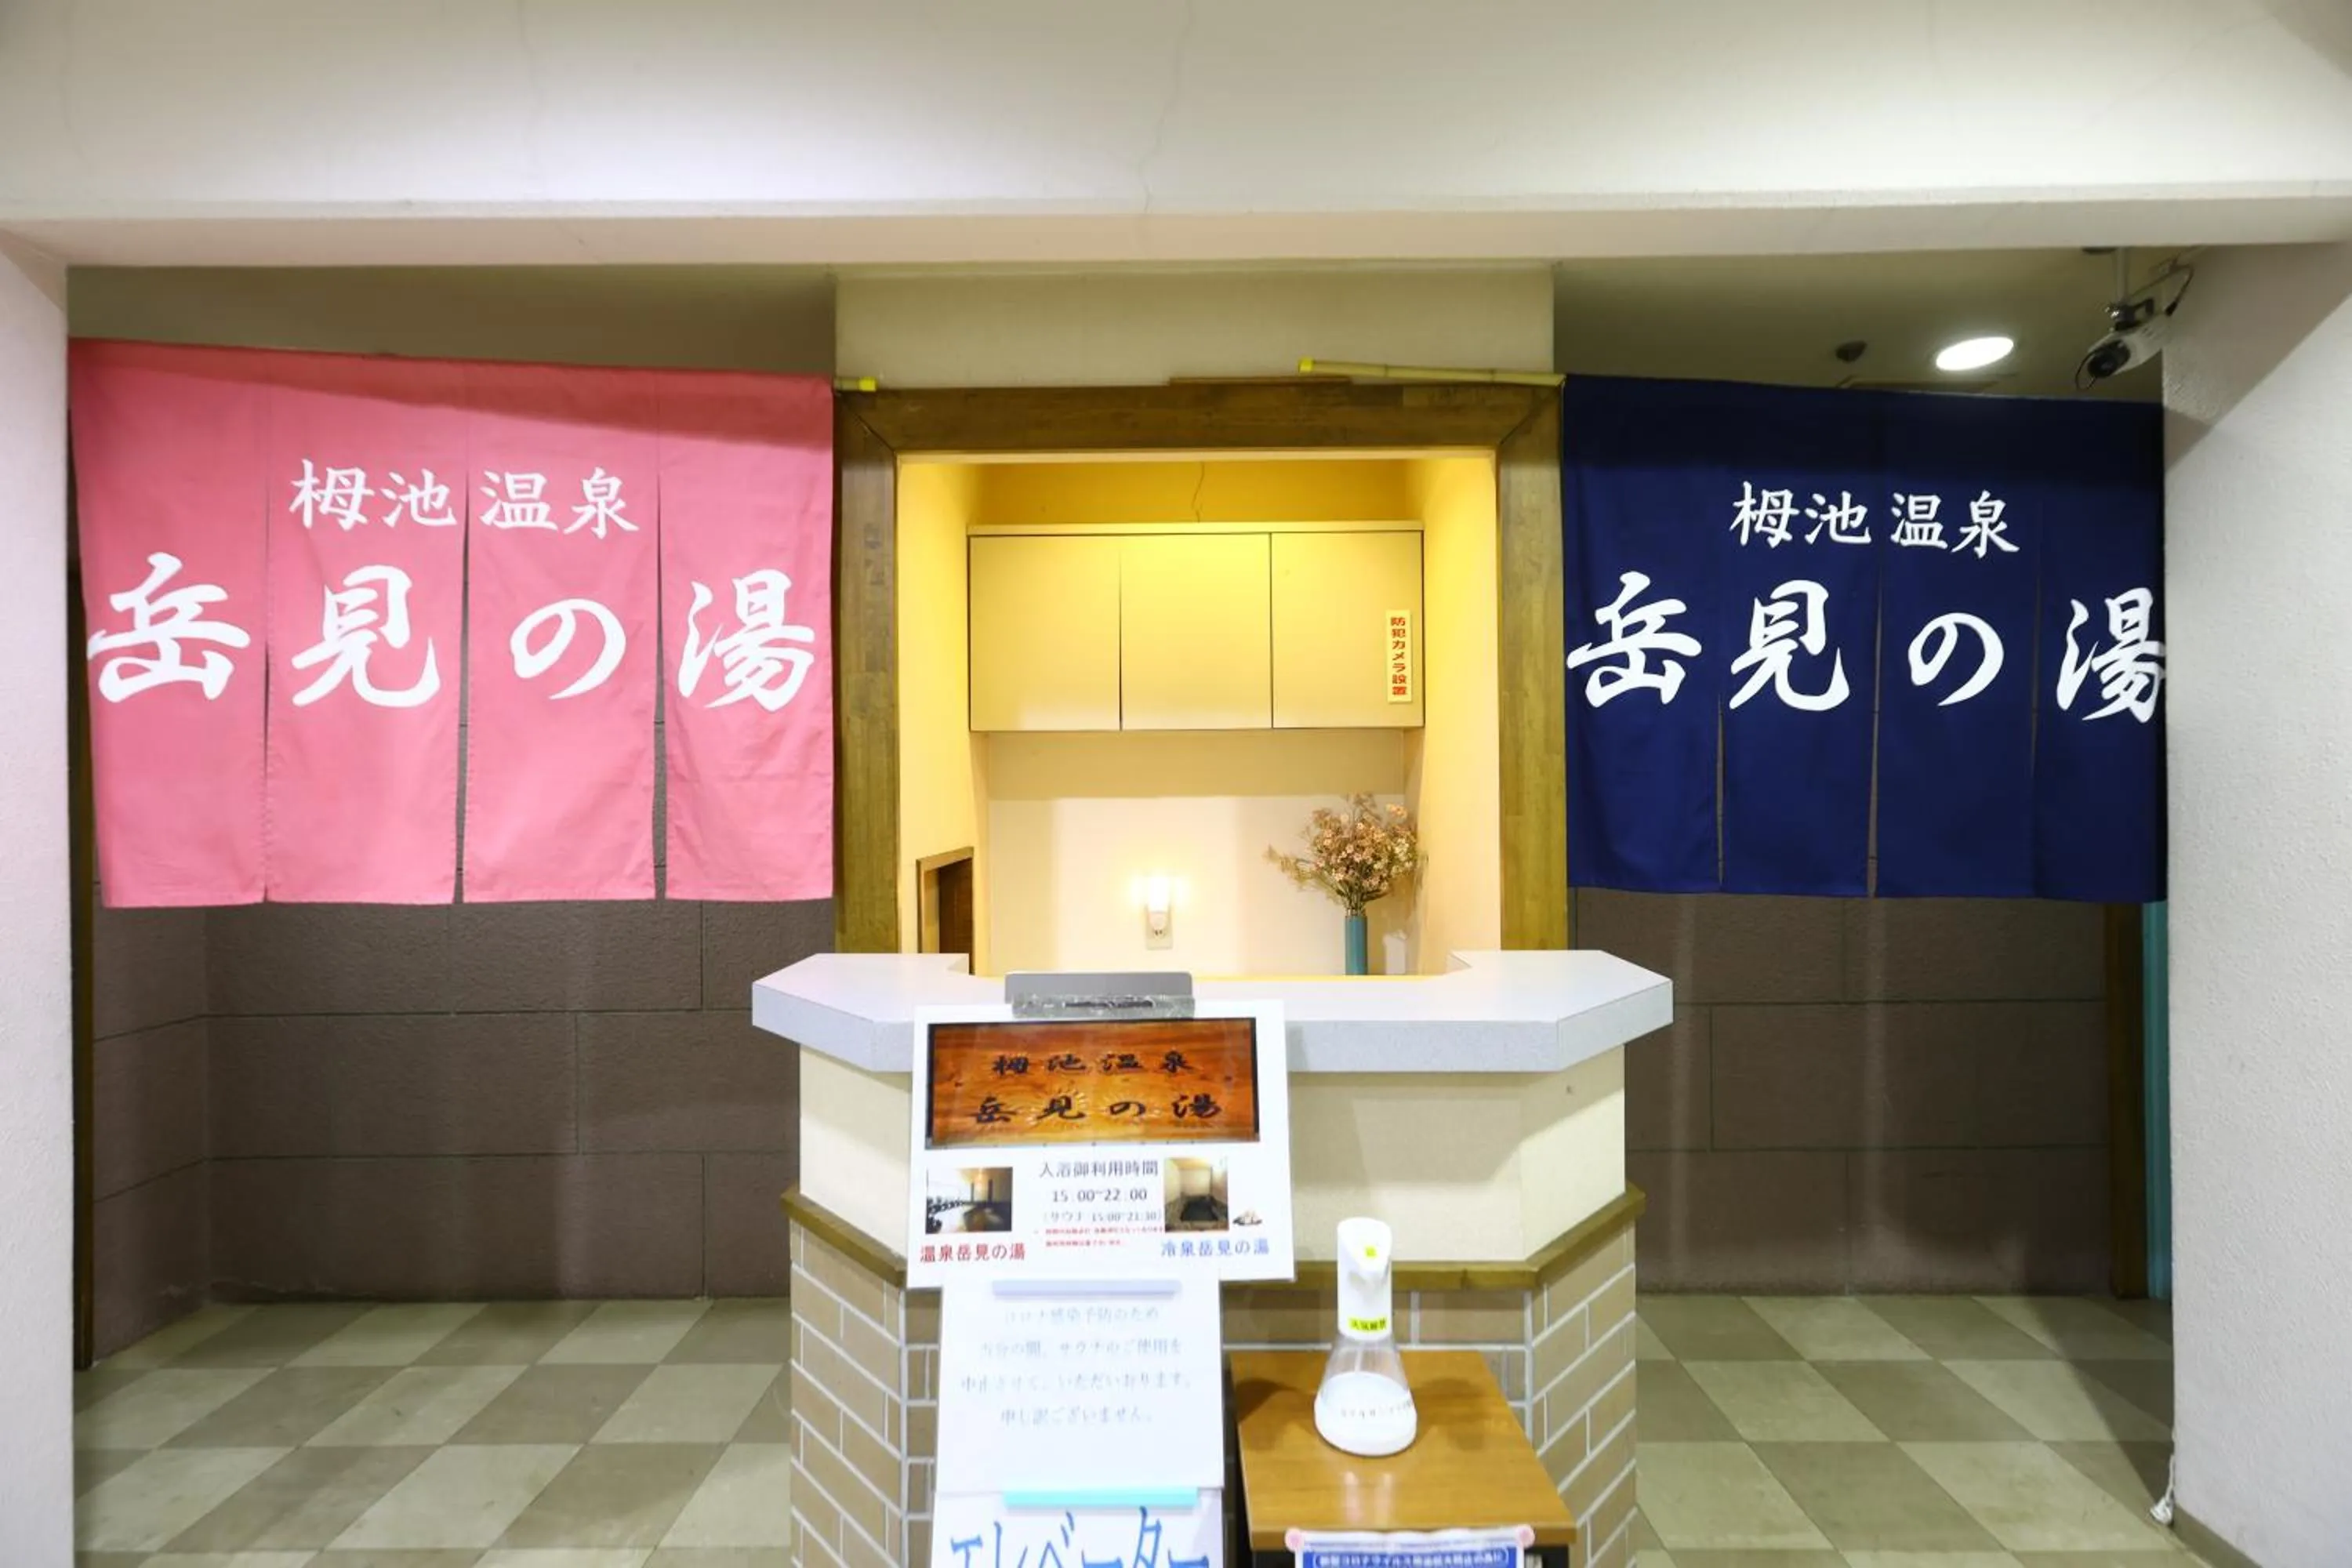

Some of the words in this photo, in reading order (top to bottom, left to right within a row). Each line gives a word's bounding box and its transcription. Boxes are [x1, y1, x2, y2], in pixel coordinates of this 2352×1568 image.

[289, 458, 640, 539] 栂池温泉
[1729, 481, 2020, 559] 栂池温泉
[86, 551, 815, 712] 岳見の湯
[1390, 616, 1407, 696] 防犯カメラ設置
[1567, 570, 2166, 724] 岳見の湯
[992, 1050, 1195, 1076] 栂池温泉
[975, 1093, 1222, 1123] 岳見の湯
